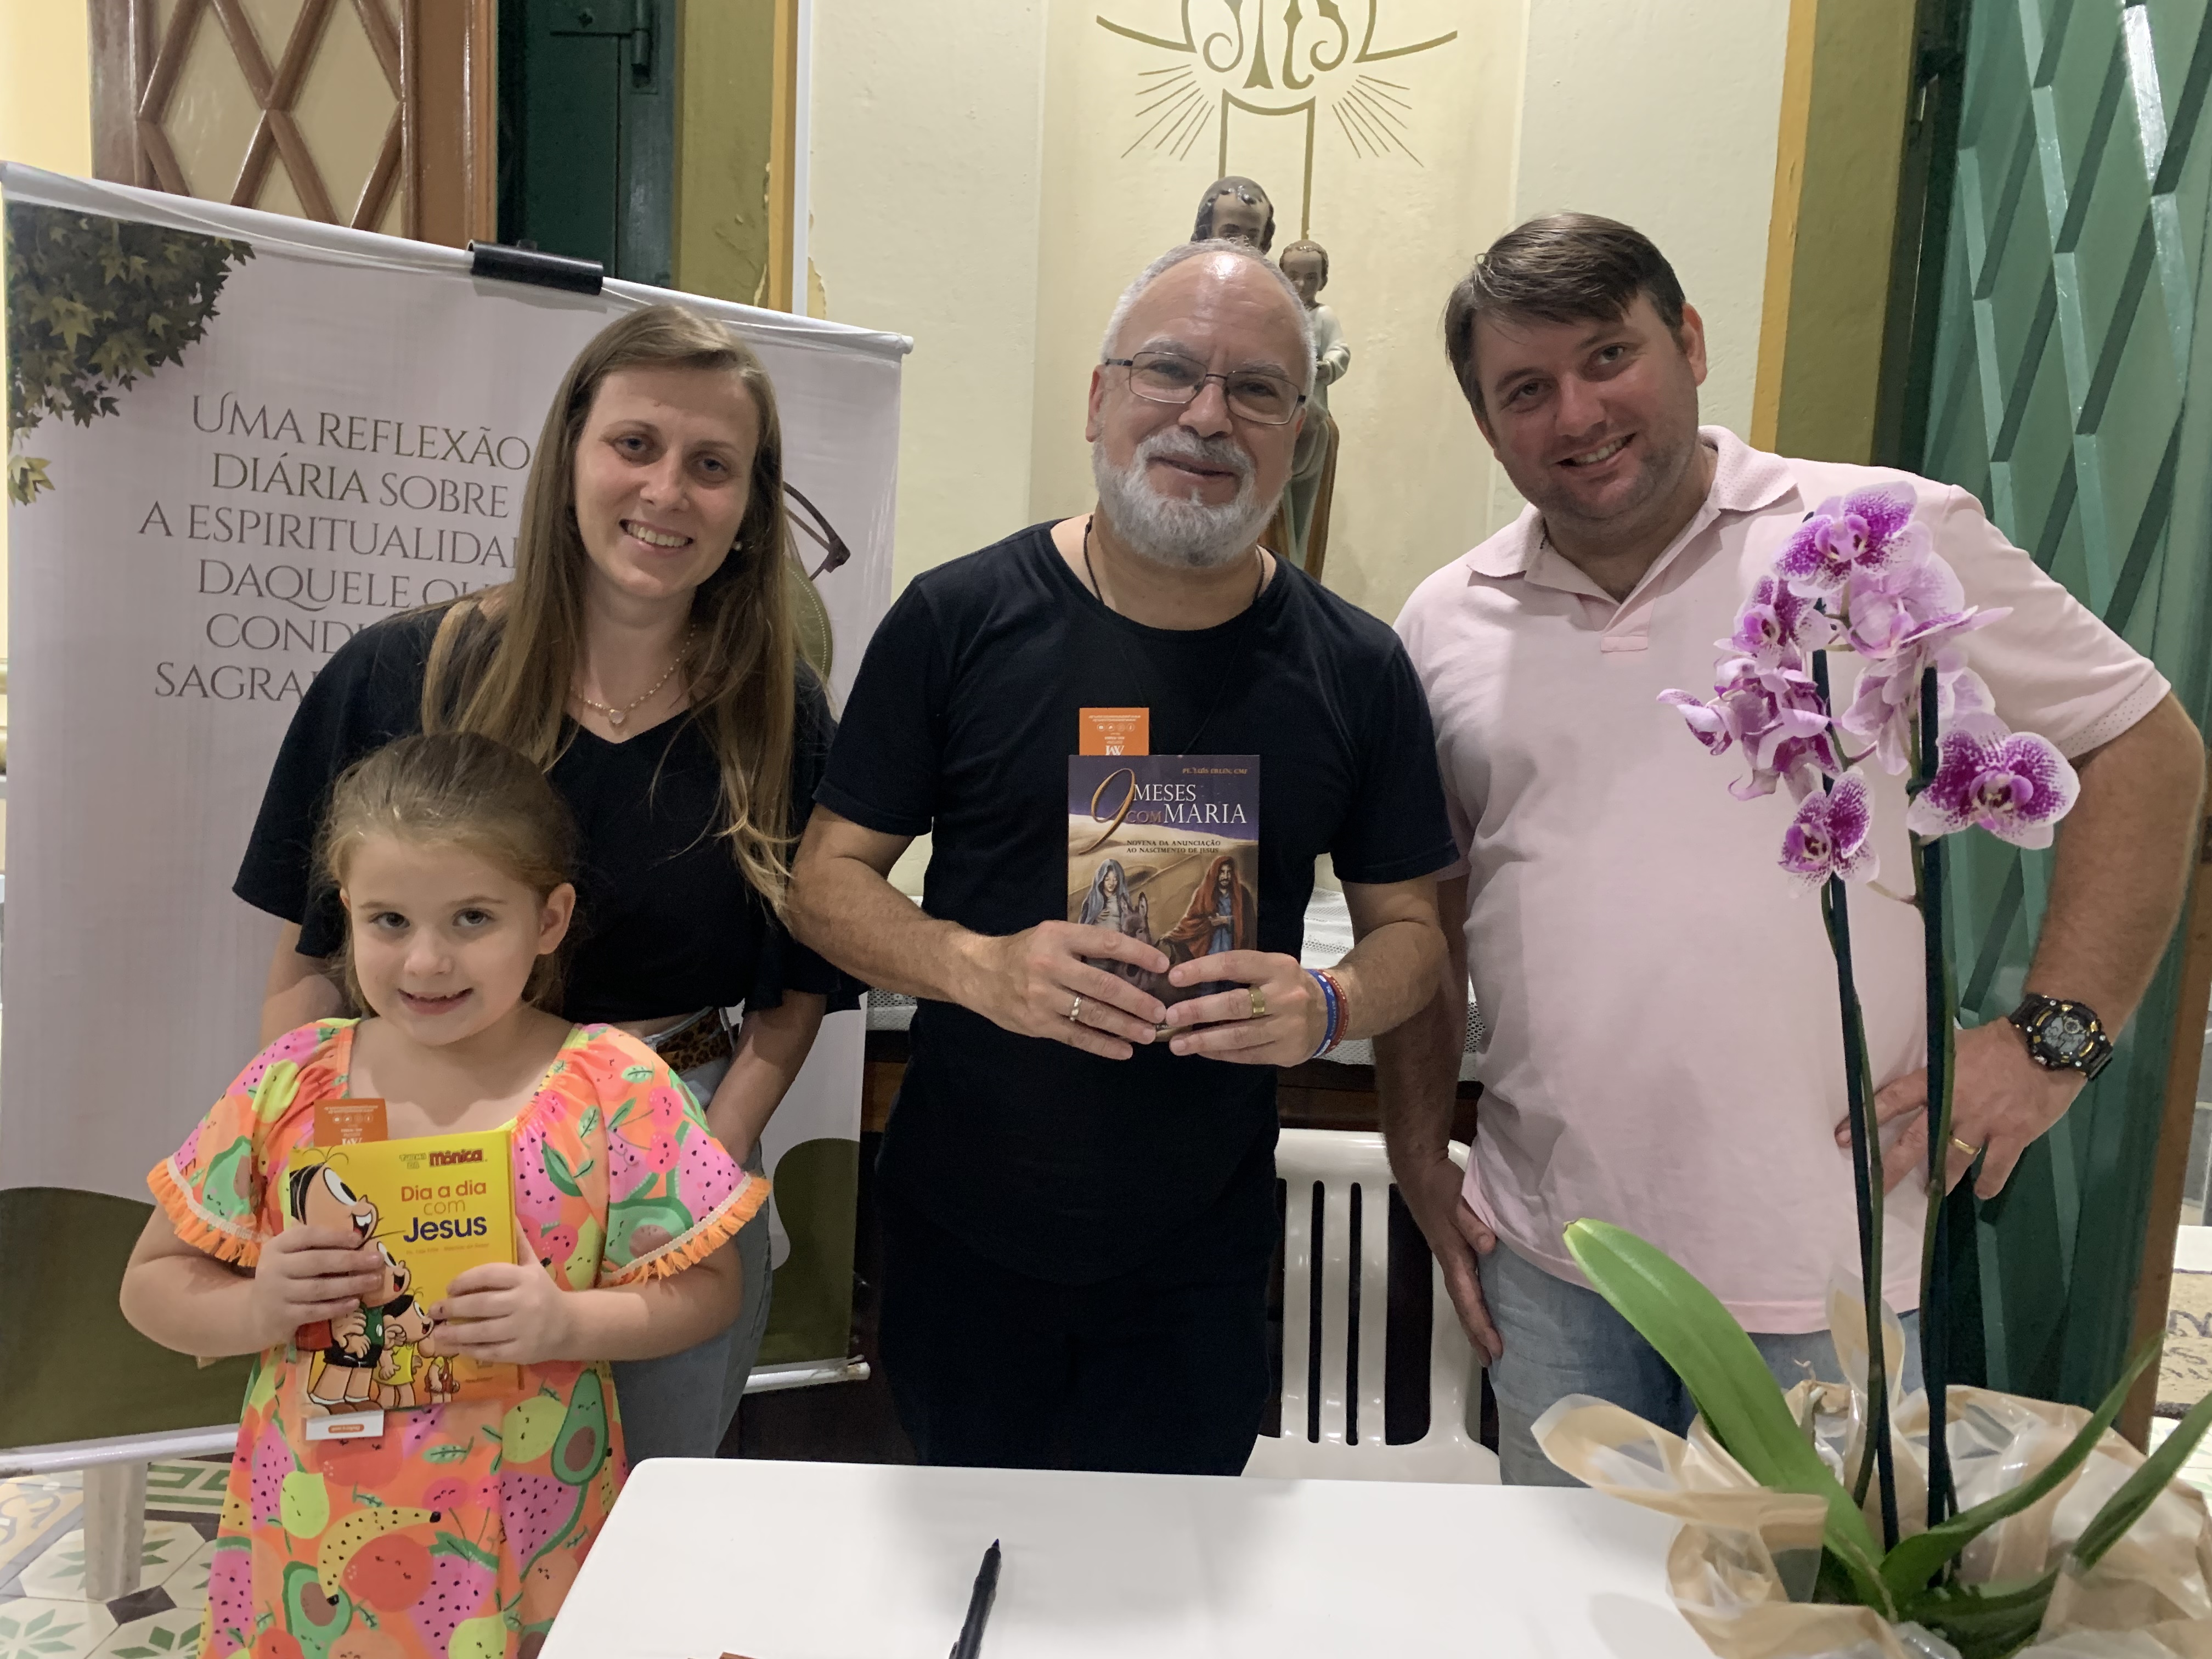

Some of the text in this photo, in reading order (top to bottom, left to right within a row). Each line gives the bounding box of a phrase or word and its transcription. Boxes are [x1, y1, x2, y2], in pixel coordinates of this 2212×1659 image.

[193, 391, 531, 470] UMA REFLEXÃO
[212, 452, 509, 518] DIÁRIA SOBRE
[138, 501, 517, 569] A ESPIRITUALIDA
[198, 559, 411, 611] DAQUELE
[206, 613, 365, 654] COND
[155, 662, 319, 703] SAGRA
[1079, 768, 1197, 855] 9 MESES
[1126, 803, 1248, 823] COM MARIA
[401, 1180, 487, 1202] Dia a dia
[424, 1199, 465, 1216] com
[403, 1216, 488, 1243] Jesus
